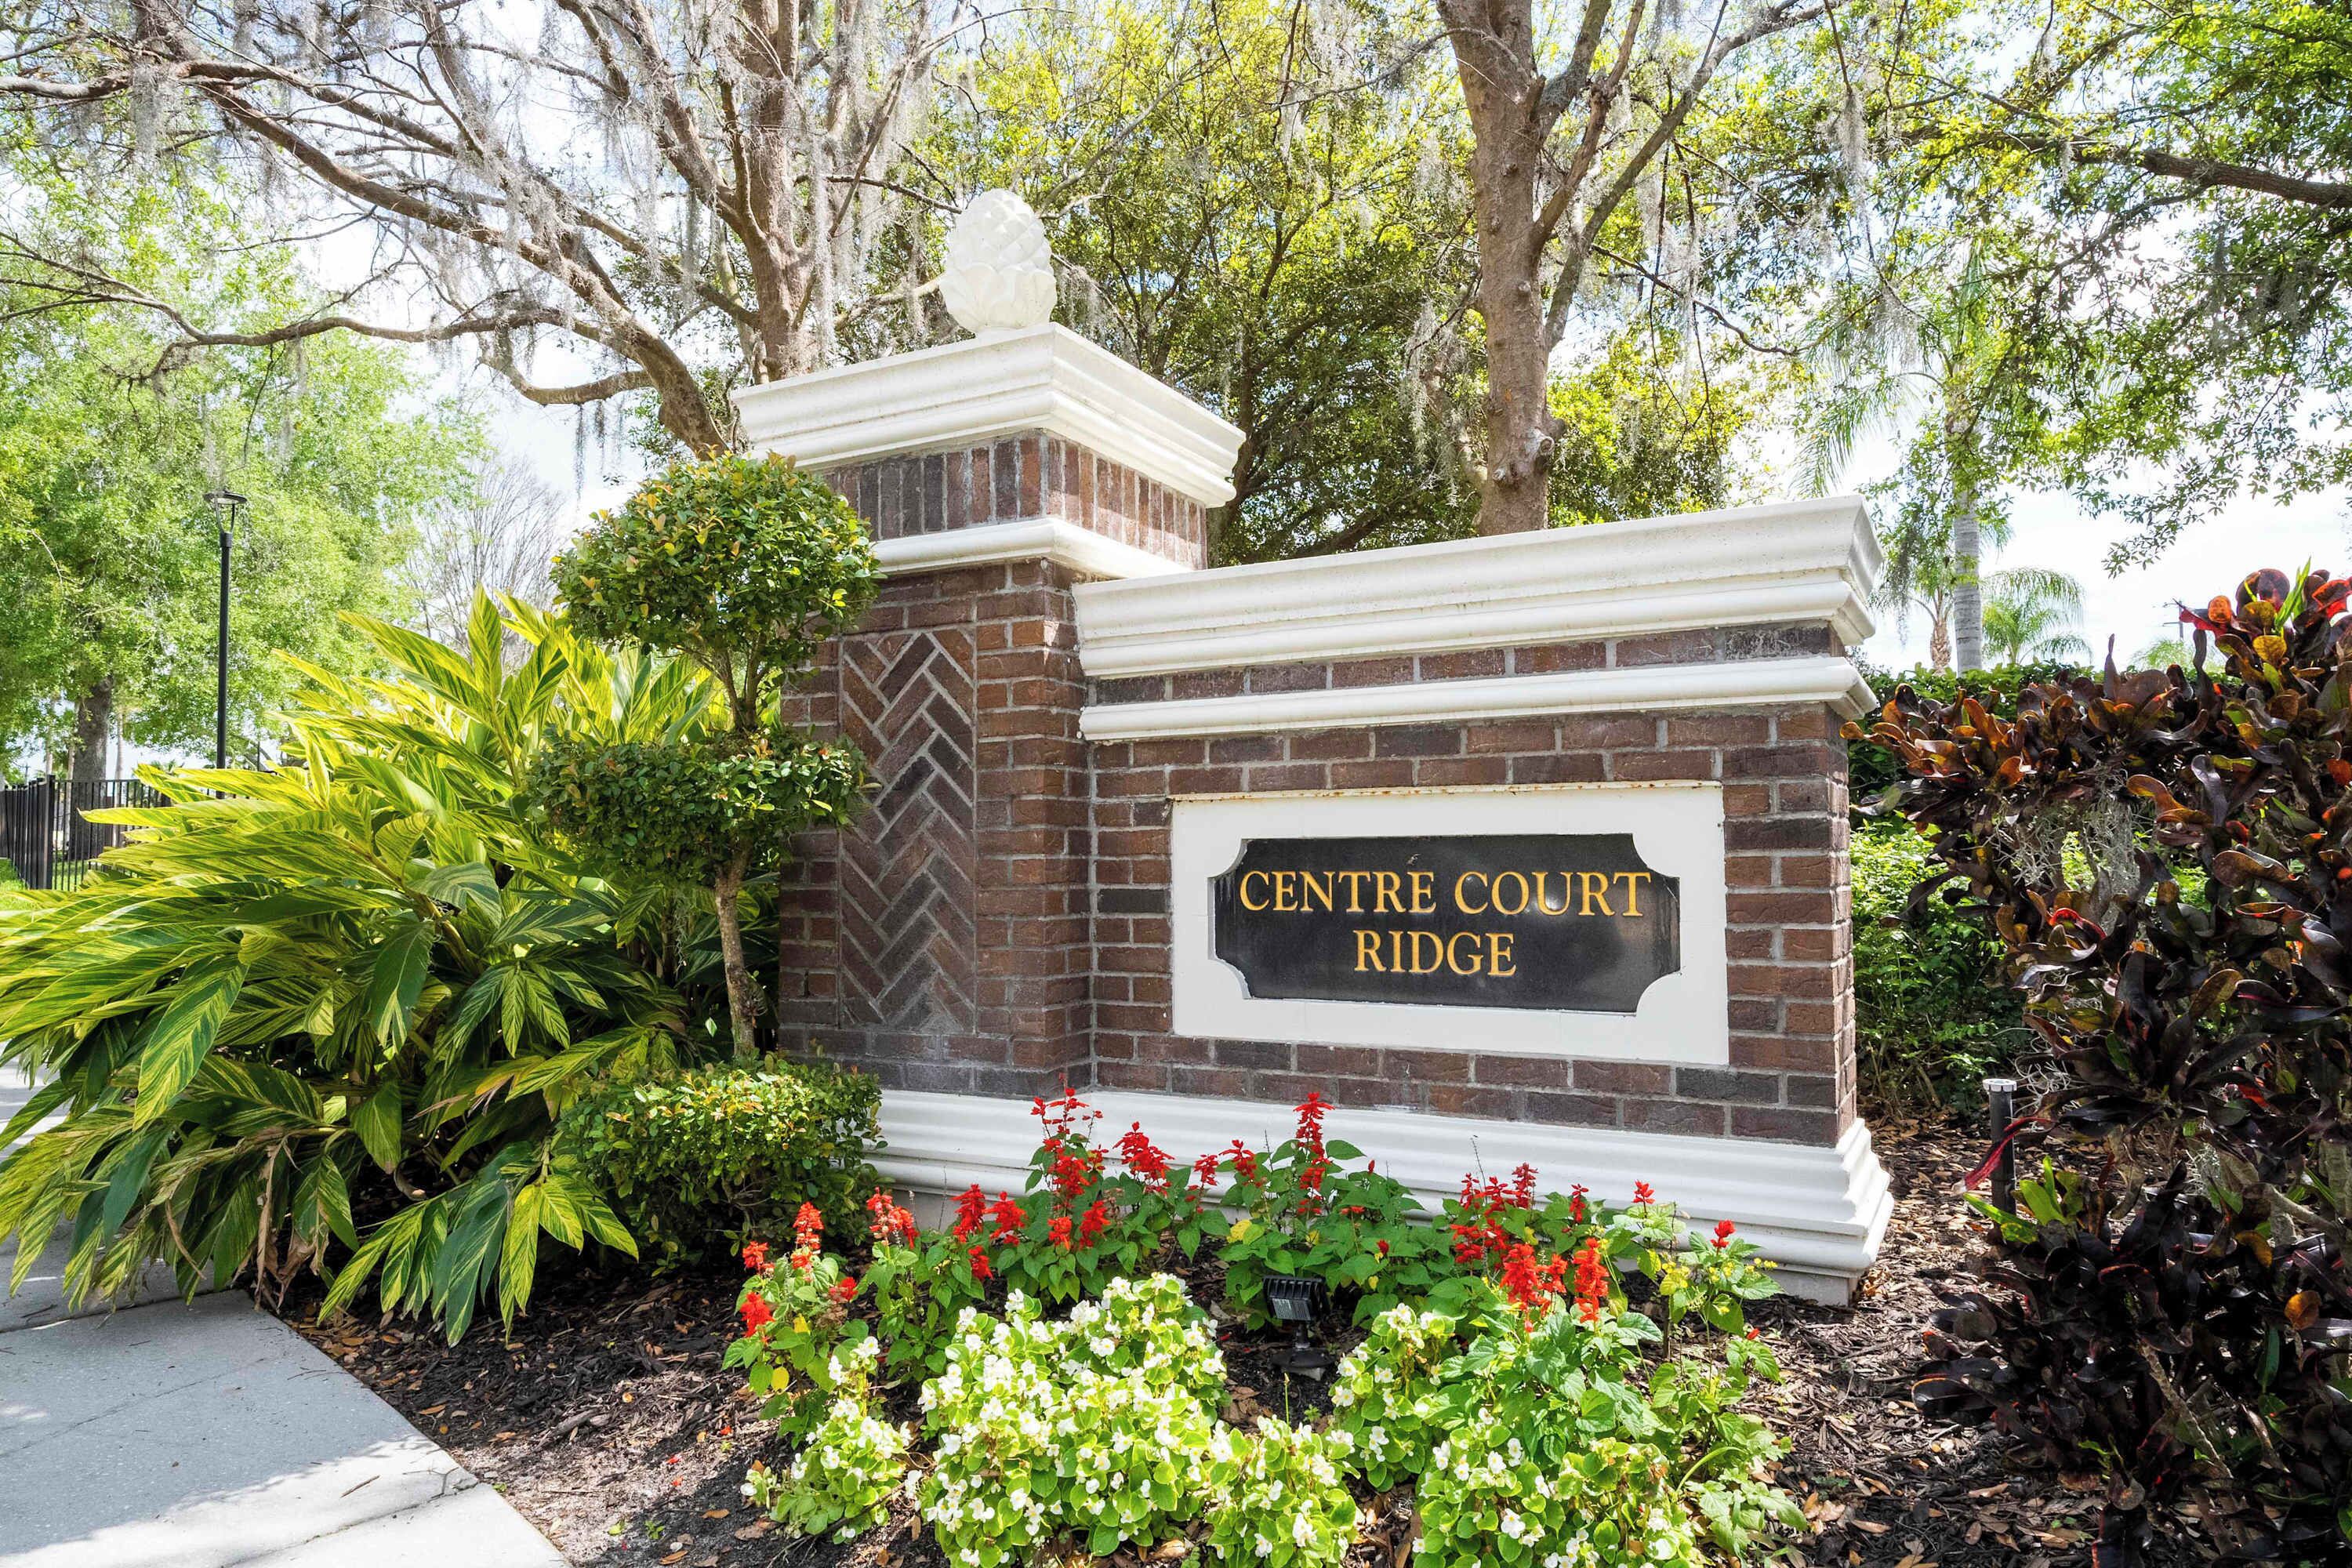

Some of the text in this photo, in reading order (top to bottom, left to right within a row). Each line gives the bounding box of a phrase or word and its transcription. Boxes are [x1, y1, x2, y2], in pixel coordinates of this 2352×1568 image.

[1239, 870, 1651, 916] CENTRE COURT
[1353, 930, 1517, 977] RIDGE
